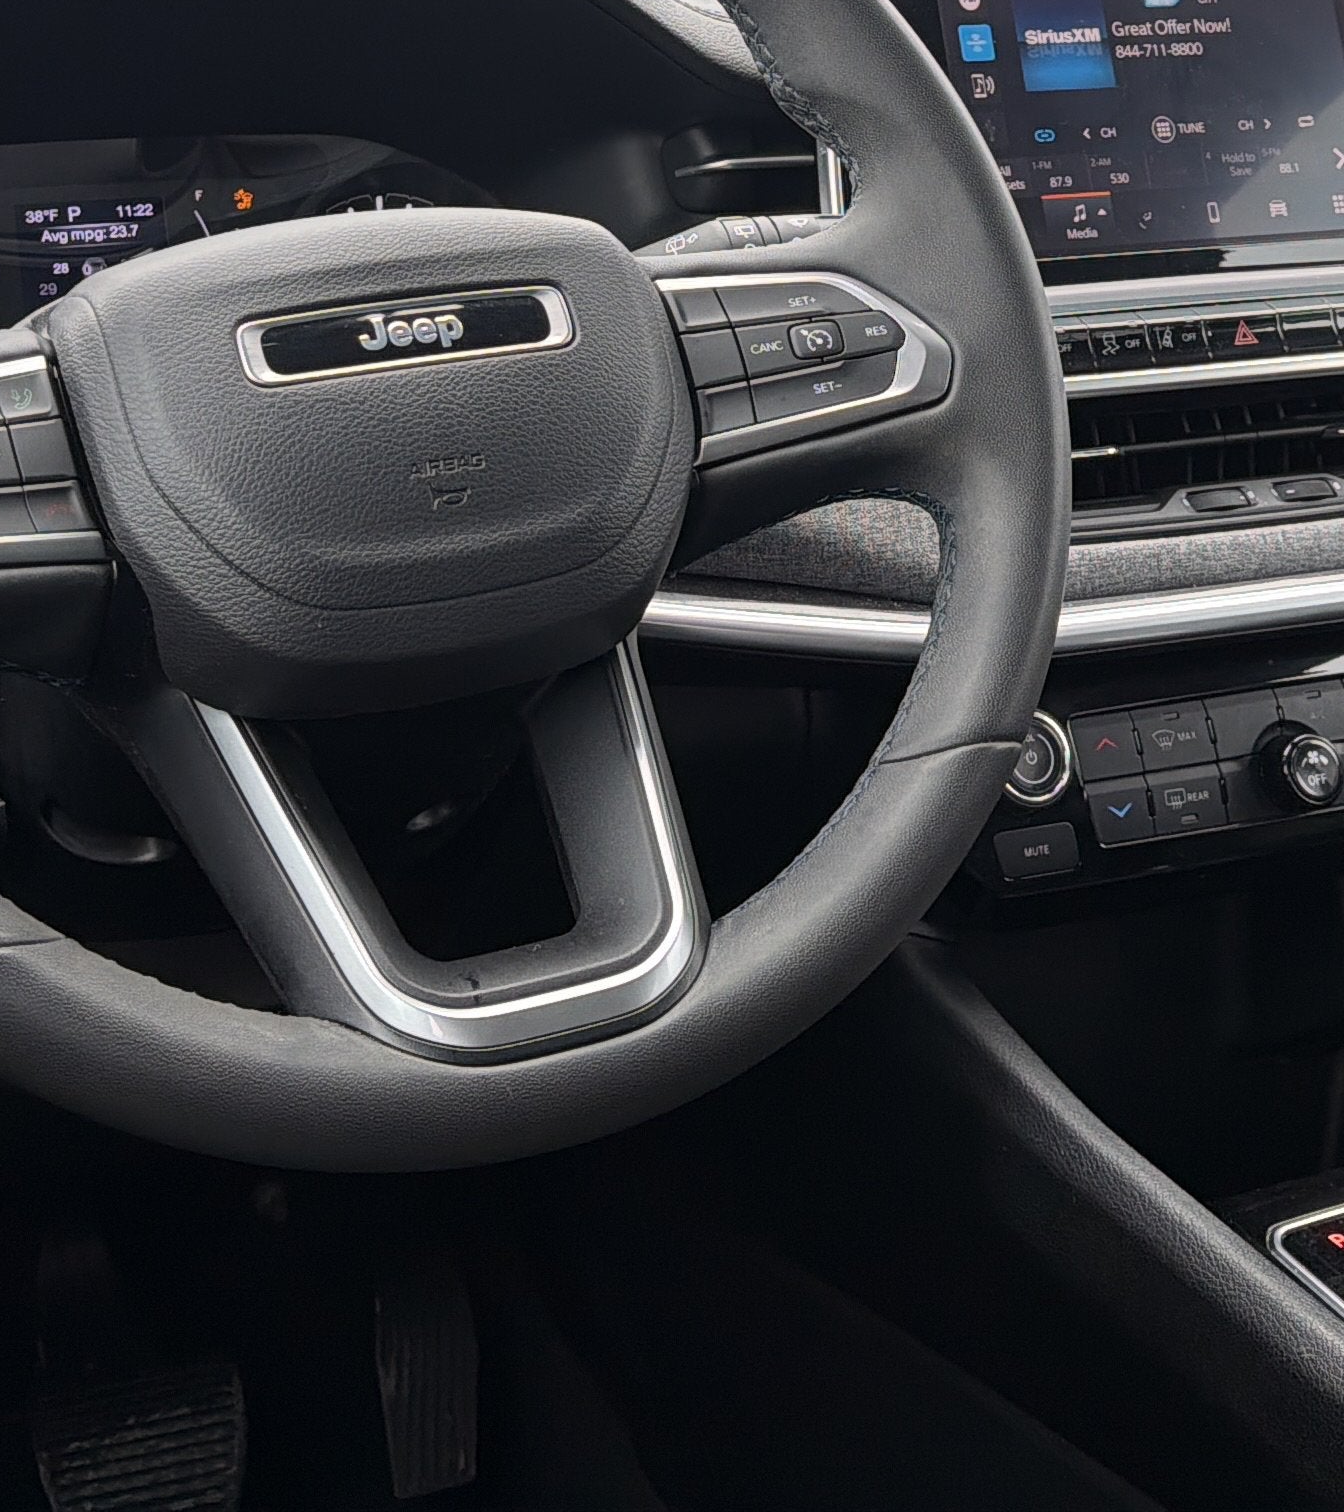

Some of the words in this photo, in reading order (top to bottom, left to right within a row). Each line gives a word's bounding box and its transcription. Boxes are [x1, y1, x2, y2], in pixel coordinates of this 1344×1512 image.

[1111, 19, 1153, 37] Great
[1155, 18, 1191, 36] Offer
[1193, 17, 1232, 35] Now!
[1024, 26, 1102, 46] SiriusXM
[1115, 40, 1203, 58] 844-711-8800
[1177, 122, 1206, 135] TUNE
[1238, 118, 1255, 131] CH
[1100, 126, 1117, 139] CH
[1221, 152, 1244, 163] Hold
[1245, 153, 1256, 162] to
[1109, 172, 1130, 185] 530
[1229, 166, 1253, 177] Save
[1049, 175, 1073, 188] 87.9
[193, 189, 204, 202] F
[24, 208, 59, 224] 38°F
[67, 206, 82, 222] P
[115, 203, 155, 218] 11:22
[41, 229, 69, 245] Avg
[70, 227, 107, 244] mpg:
[109, 224, 139, 240] 23.7
[1066, 227, 1099, 241] Media
[52, 262, 70, 275] 28
[39, 283, 58, 297] 29
[359, 310, 465, 351] Jeep
[864, 324, 889, 338] RES
[1181, 332, 1197, 343] OFF
[750, 339, 784, 356] CANC
[1124, 338, 1141, 349] OFF
[1178, 729, 1198, 742] MAX
[1308, 772, 1328, 787] OFF
[1186, 789, 1210, 803] REAR
[1023, 843, 1051, 858] MUTE
